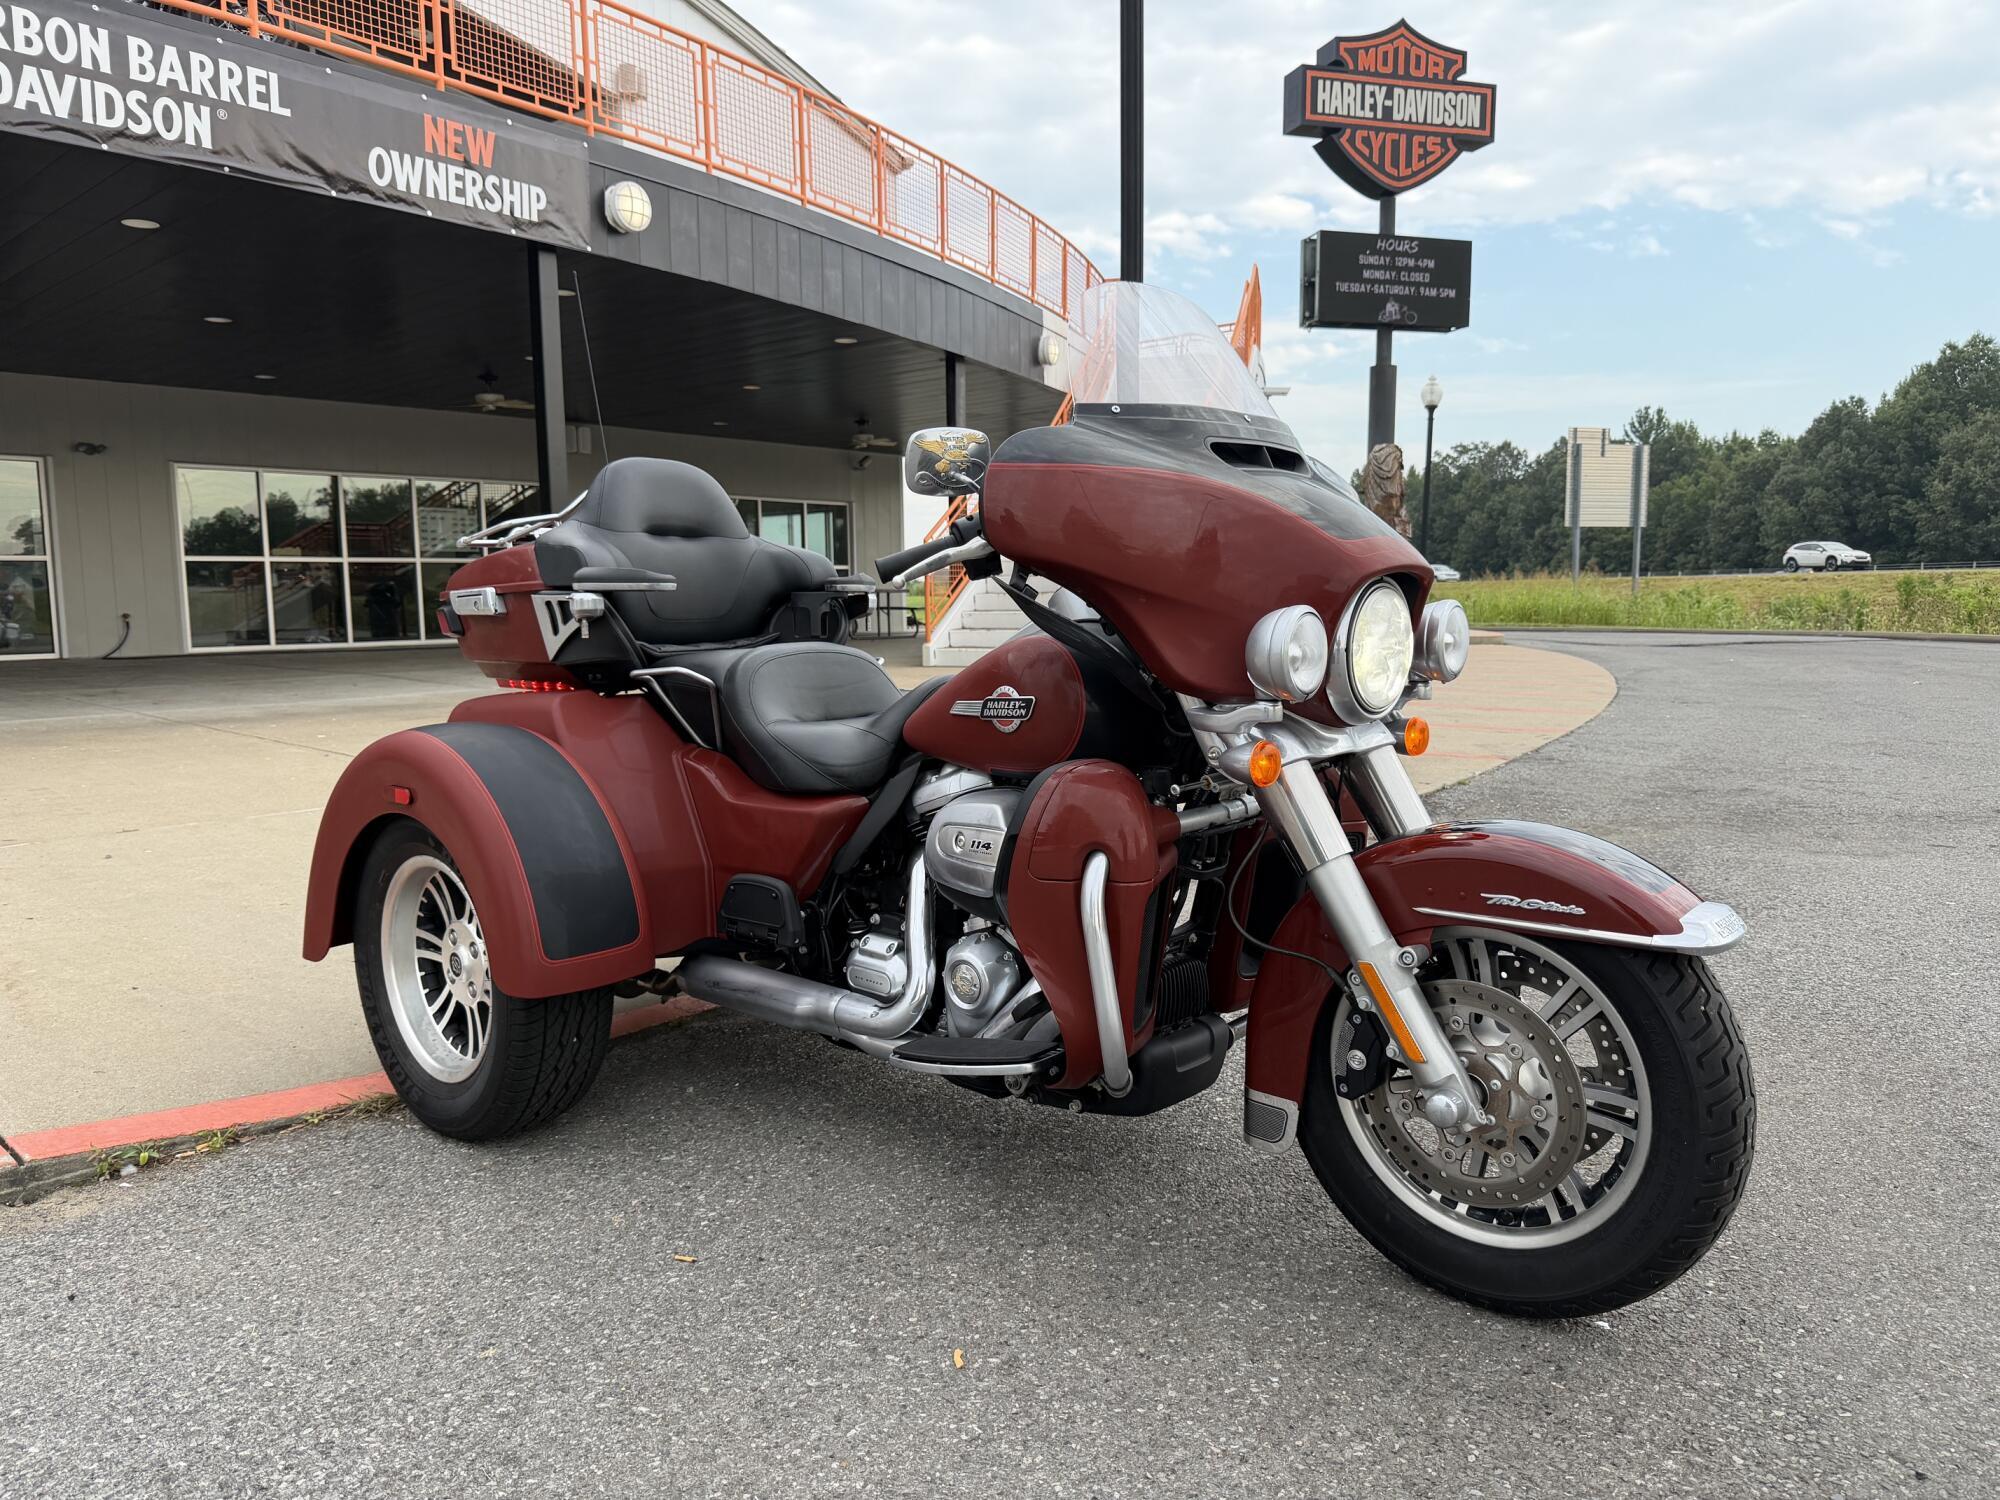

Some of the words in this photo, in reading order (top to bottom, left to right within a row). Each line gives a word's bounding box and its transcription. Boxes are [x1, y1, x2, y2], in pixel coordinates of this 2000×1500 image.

[1358, 37, 1445, 79] MOTOR
[127, 35, 291, 117] BARREL
[1316, 79, 1481, 128] HARLEY-DAVIDSON
[423, 114, 495, 169] NEW
[1355, 130, 1442, 177] CYCLES
[369, 146, 547, 222] OWNERSHIP
[1376, 239, 1419, 253] HOURS
[1359, 254, 1393, 267] SUNDAY:
[1395, 256, 1435, 268] 12PM-4PM
[1363, 269, 1398, 281] MONDAY:
[1400, 271, 1430, 282] CLOSED
[1420, 285, 1456, 298] 9AM-5PM
[987, 701, 1026, 709] HARLEY-
[984, 708, 1026, 717] DAVIDSON
[971, 840, 992, 850] 114
